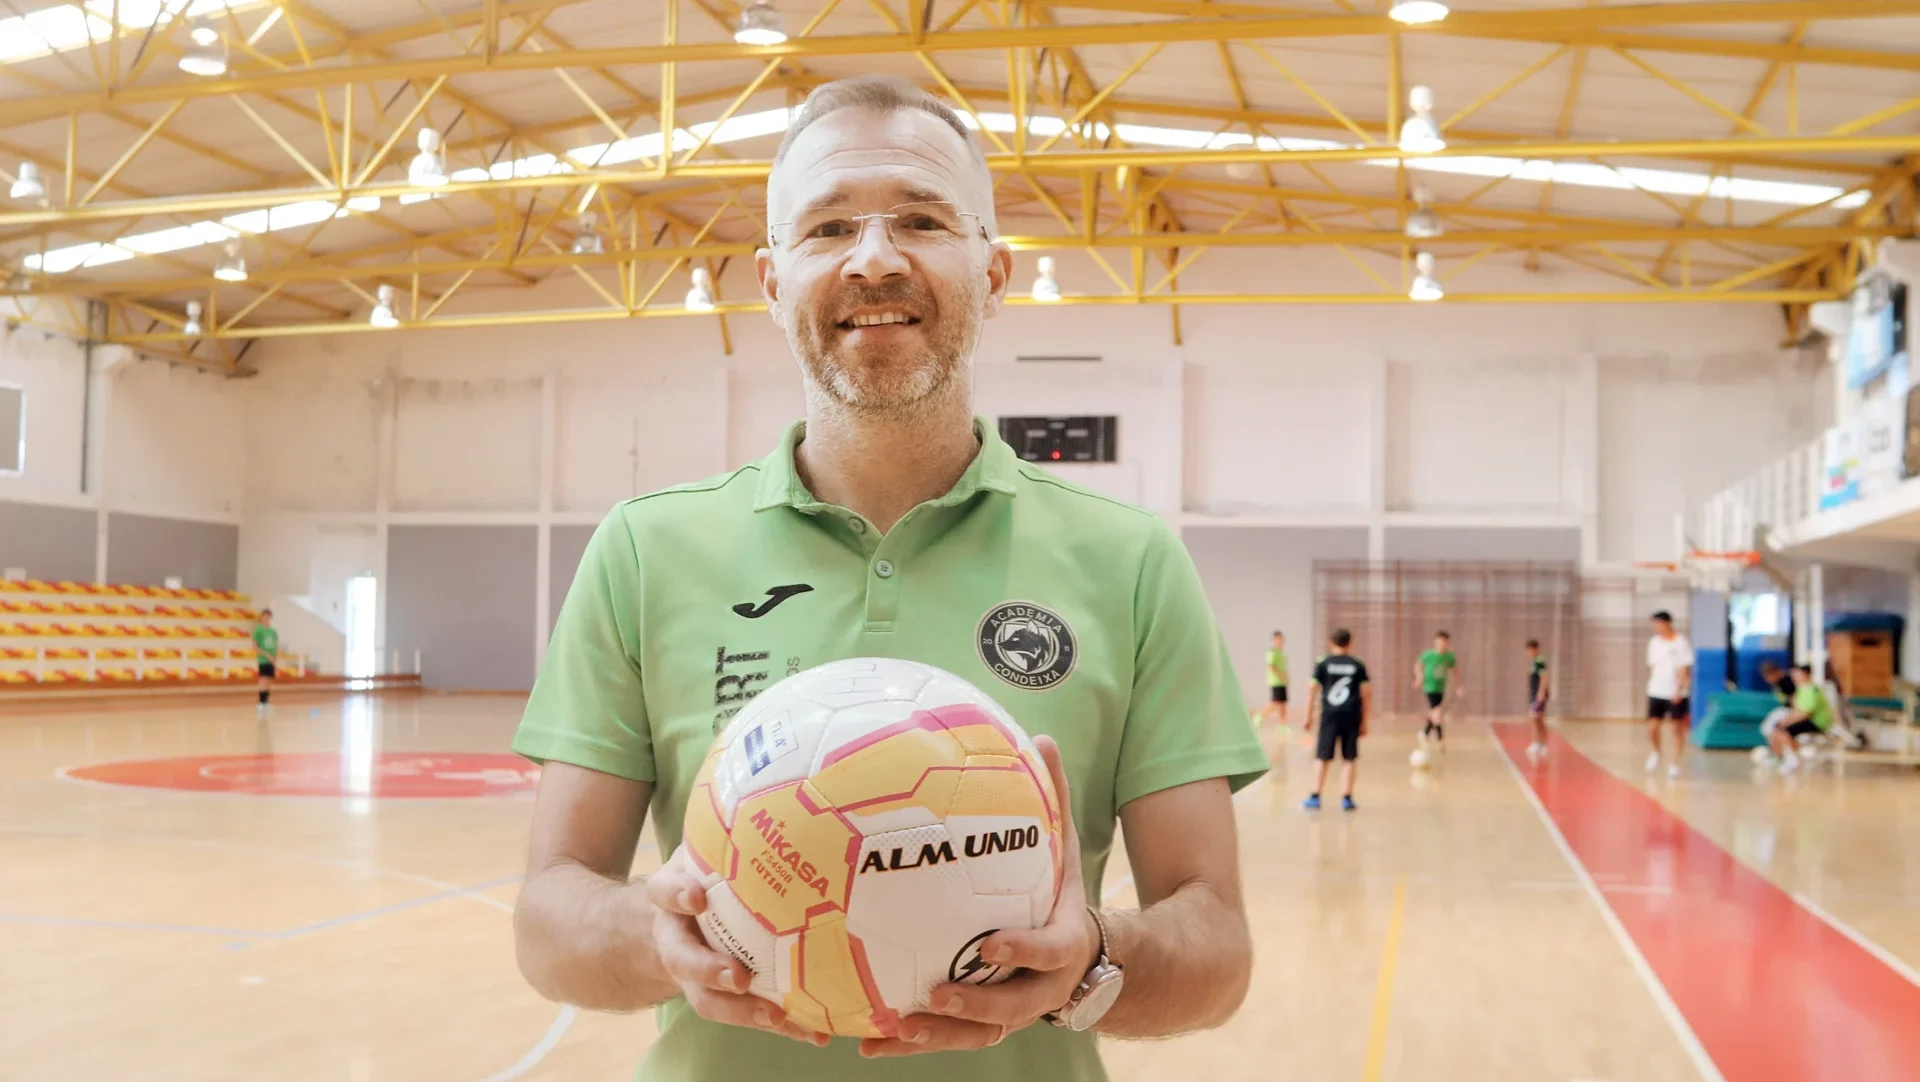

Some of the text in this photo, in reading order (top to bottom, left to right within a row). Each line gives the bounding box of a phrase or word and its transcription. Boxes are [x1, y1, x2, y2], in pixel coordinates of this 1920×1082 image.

[990, 607, 1062, 633] ACADEMIA
[994, 663, 1061, 686] CONDEIXA
[1328, 675, 1352, 706] 6
[750, 857, 787, 898] FUTSAL
[711, 912, 755, 965] OFFICIAL
